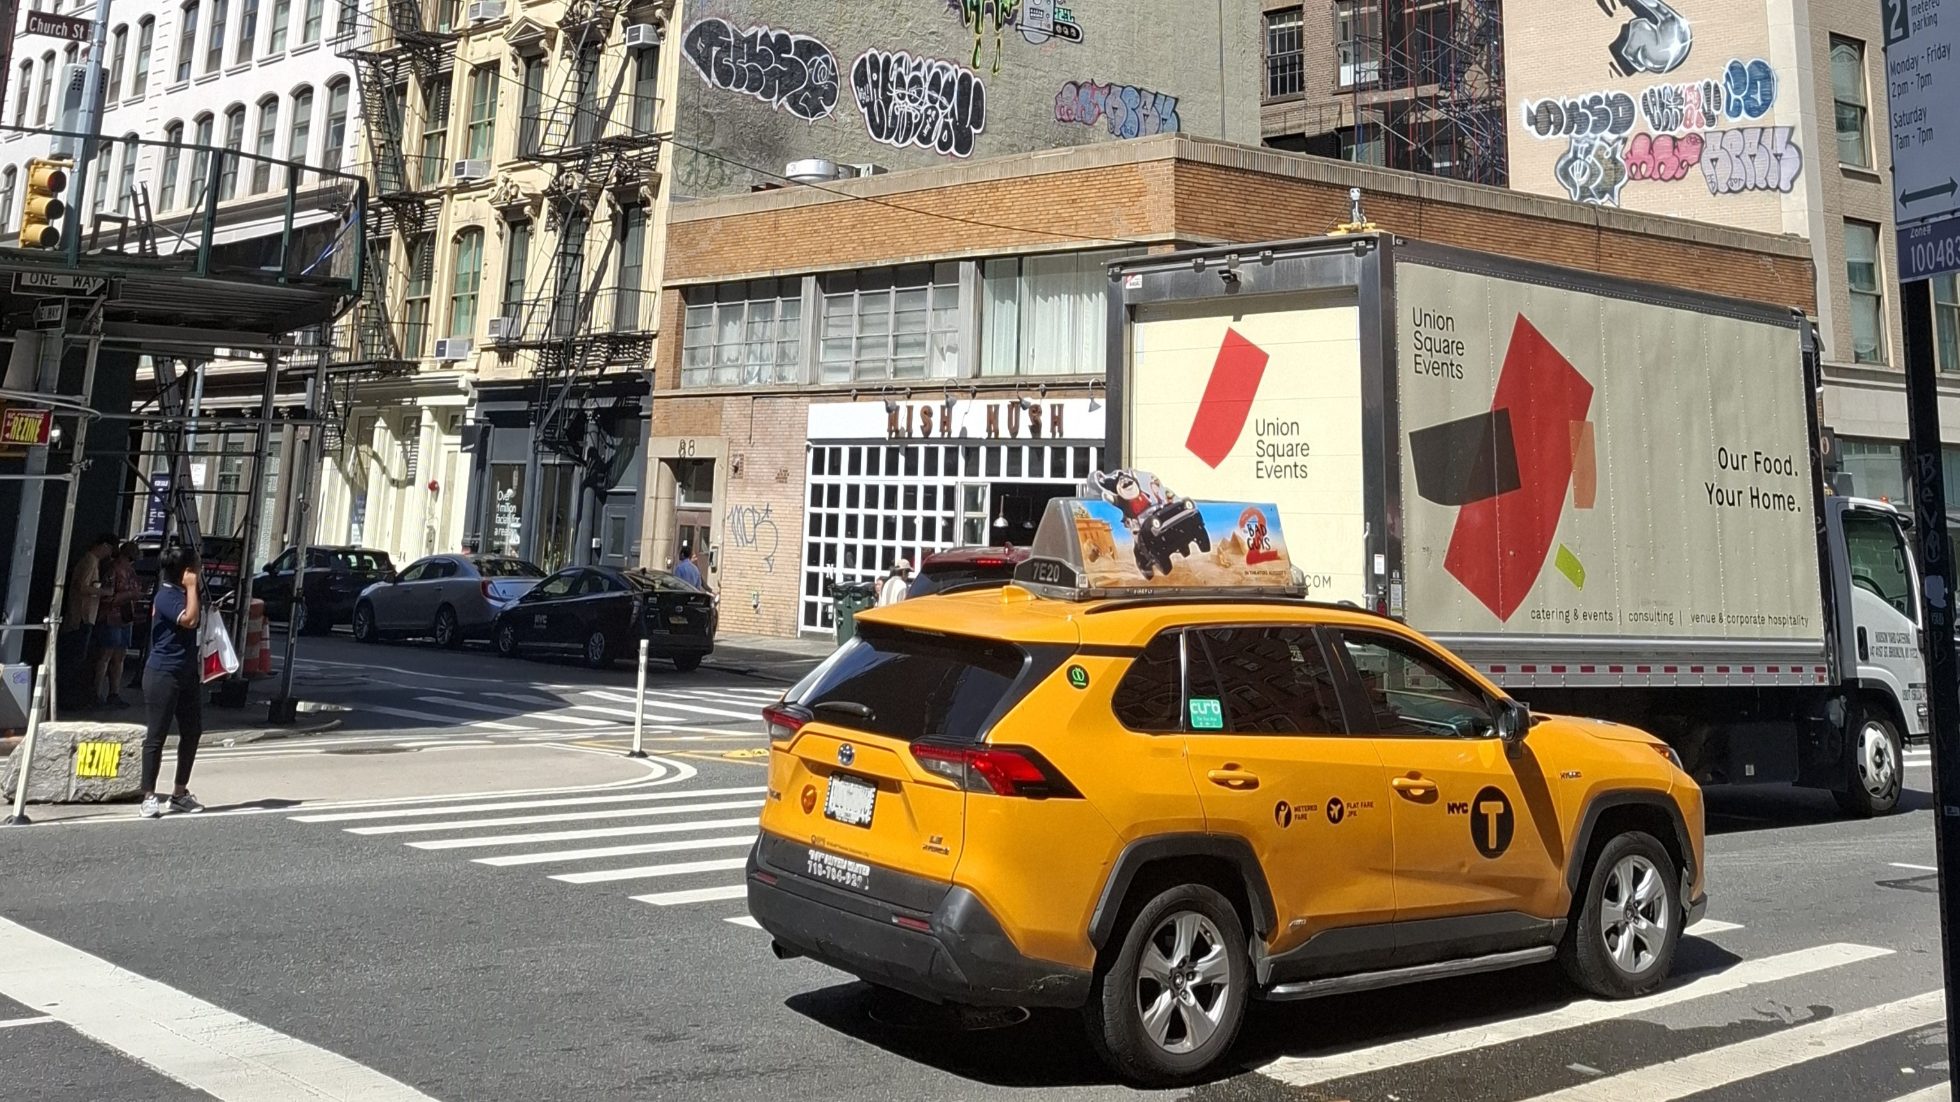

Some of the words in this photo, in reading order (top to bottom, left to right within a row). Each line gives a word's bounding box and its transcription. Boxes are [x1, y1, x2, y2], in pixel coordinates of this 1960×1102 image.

[1888, 0, 1904, 40] 2
[1911, 0, 1940, 17] metered
[29, 16, 68, 37] Church
[72, 24, 84, 39] St
[1912, 12, 1938, 35] parking
[1890, 54, 1919, 77] Monday
[1926, 42, 1951, 66] Friday
[1891, 80, 1909, 100] 2pm
[1915, 72, 1933, 92] 7pm
[1893, 106, 1928, 129] Saturday
[1894, 134, 1911, 151] 7am
[1917, 127, 1934, 147] 7pm
[1911, 235, 1960, 273] 100483
[30, 273, 58, 285] ONE
[73, 276, 97, 288] WAY
[1413, 306, 1455, 332] Union
[1413, 330, 1465, 358] Square
[1414, 353, 1464, 380] Events
[986, 401, 1065, 437] NUSH
[1255, 417, 1300, 437] Union
[679, 439, 695, 457] 88
[1255, 439, 1310, 463] Square
[1256, 460, 1308, 479] Events
[1718, 447, 1748, 471] Our
[1754, 451, 1798, 477] Food.
[1704, 481, 1743, 507] Your
[1749, 486, 1801, 512] Home.
[1247, 523, 1267, 537] BAD
[1247, 537, 1271, 550] GUYS
[1033, 562, 1060, 583] 7E20
[1531, 609, 1570, 623] catering
[1573, 609, 1579, 620] &
[1582, 611, 1614, 622] events
[1628, 610, 1674, 625] consulting
[1690, 613, 1716, 624] venue
[1718, 612, 1724, 624] &
[1726, 613, 1766, 627] corporate
[1768, 613, 1809, 628] hospitality
[1190, 699, 1220, 715] curb
[76, 742, 121, 777] REZINE
[1294, 804, 1318, 813] METERED
[1360, 801, 1374, 809] FARE
[1447, 802, 1469, 815] NYC
[1294, 813, 1308, 821] FARE
[1479, 801, 1504, 850] T
